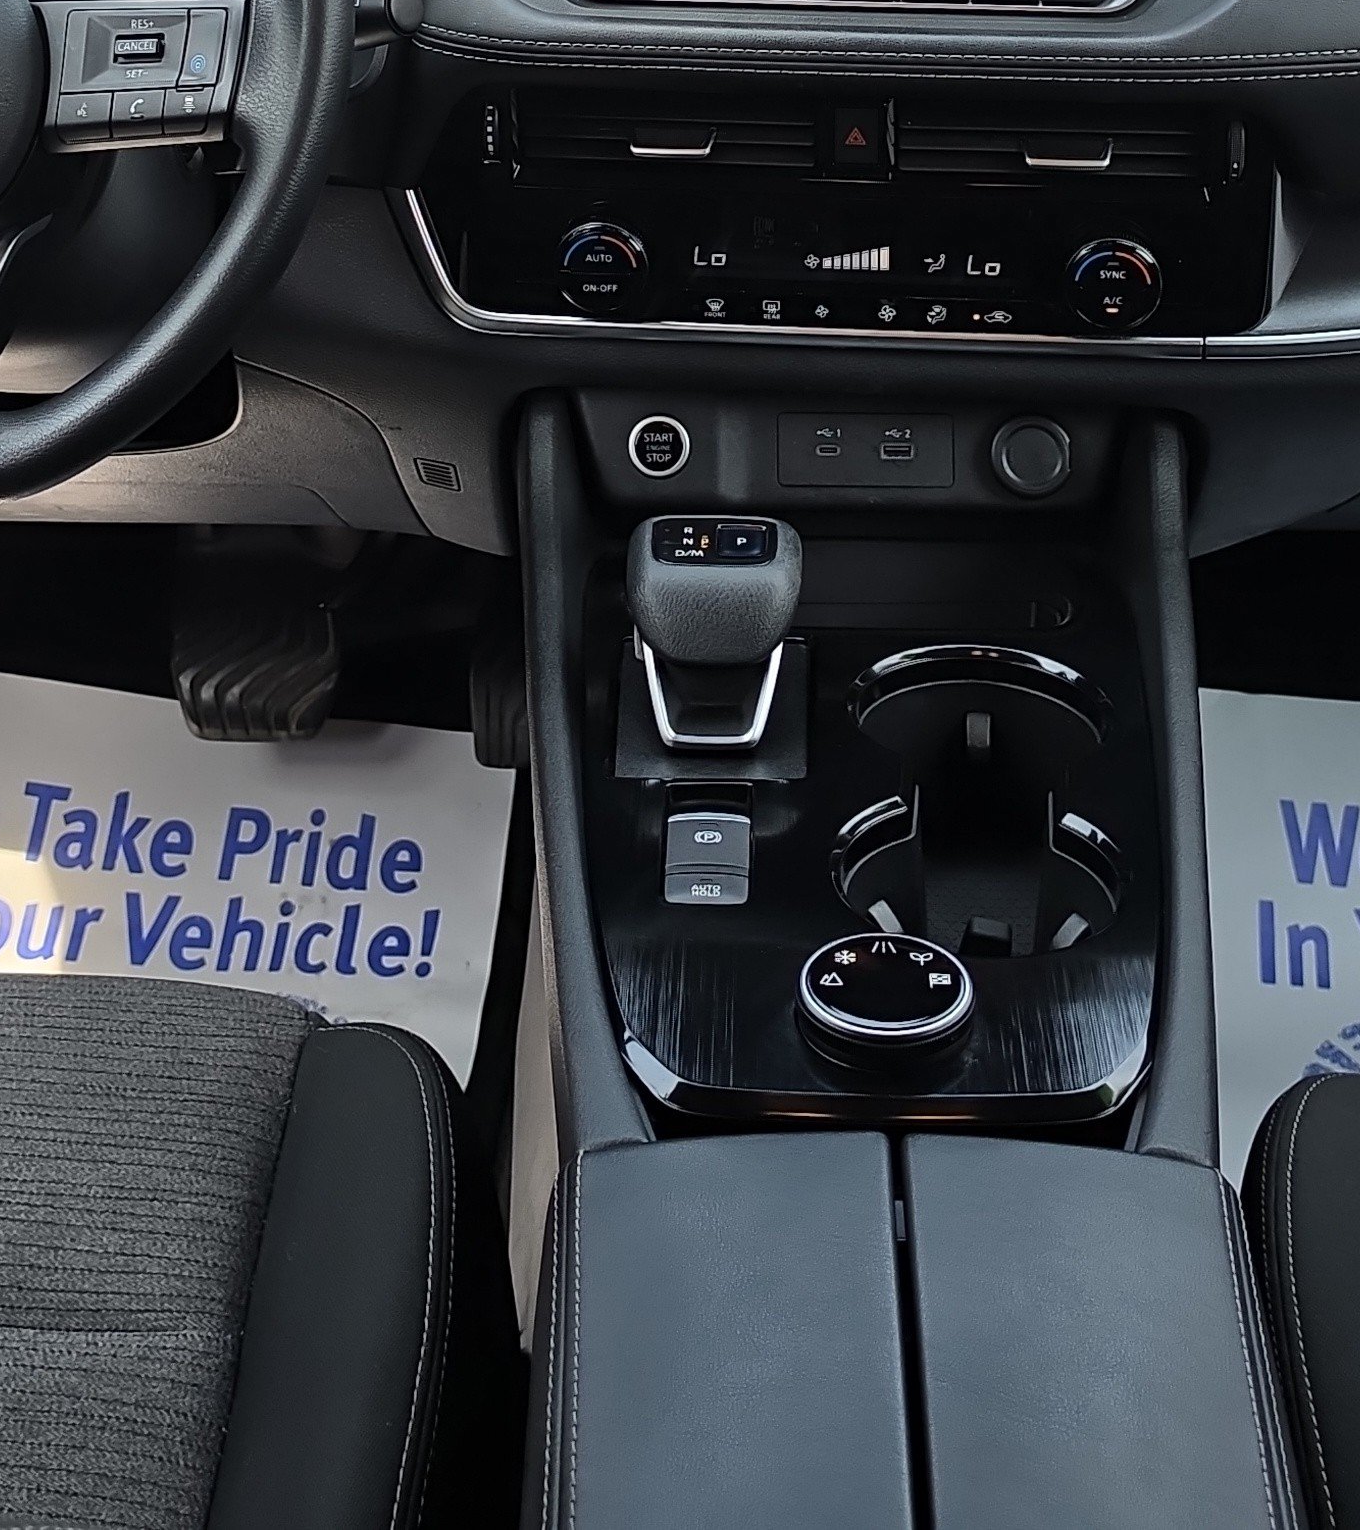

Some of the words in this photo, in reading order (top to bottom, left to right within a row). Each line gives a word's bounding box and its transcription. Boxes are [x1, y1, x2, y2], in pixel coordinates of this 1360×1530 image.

[130, 19, 155, 30] RES+
[117, 41, 155, 52] CANCEL
[584, 253, 613, 263] AUTO
[1099, 270, 1127, 280] SYNC
[582, 283, 619, 293] ON-OFF
[1102, 296, 1124, 305] A/C
[643, 433, 675, 443] START
[904, 428, 911, 439] 2
[646, 453, 672, 463] STOP
[683, 526, 694, 534] R
[682, 537, 694, 546] N
[736, 537, 748, 546] P
[674, 549, 704, 558] D/M
[21, 779, 196, 880] Take
[217, 806, 425, 896] Pride
[123, 889, 442, 979] Vehicle!
[1256, 898, 1332, 991] In
